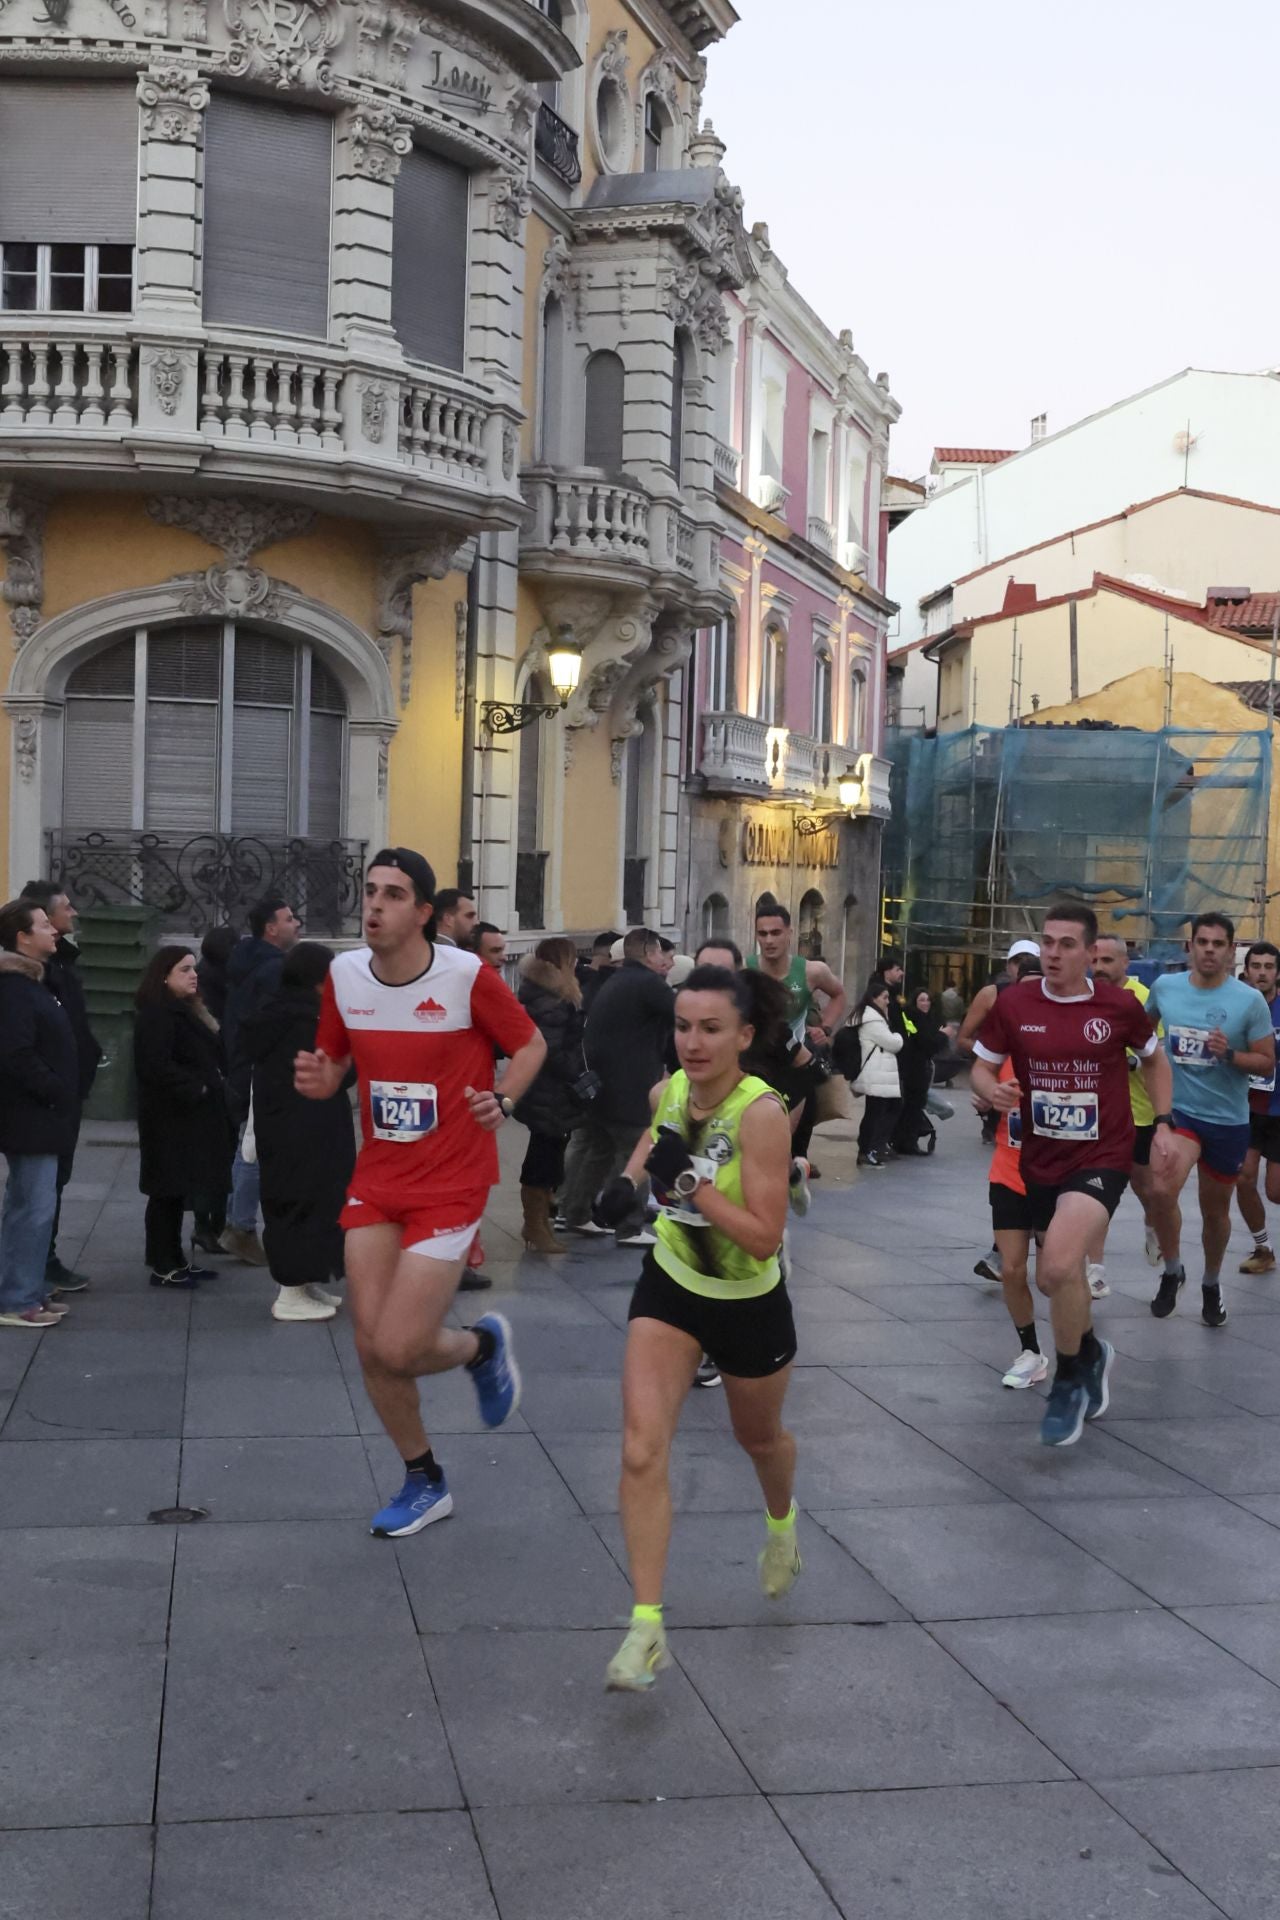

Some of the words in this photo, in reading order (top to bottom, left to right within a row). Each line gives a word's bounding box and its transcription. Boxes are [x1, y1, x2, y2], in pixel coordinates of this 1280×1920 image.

[1178, 1037, 1205, 1059] 827
[1052, 1062, 1070, 1073] vez
[1073, 1059, 1101, 1073] Sider
[380, 1100, 421, 1127] 1241
[1042, 1106, 1087, 1128] 1240
